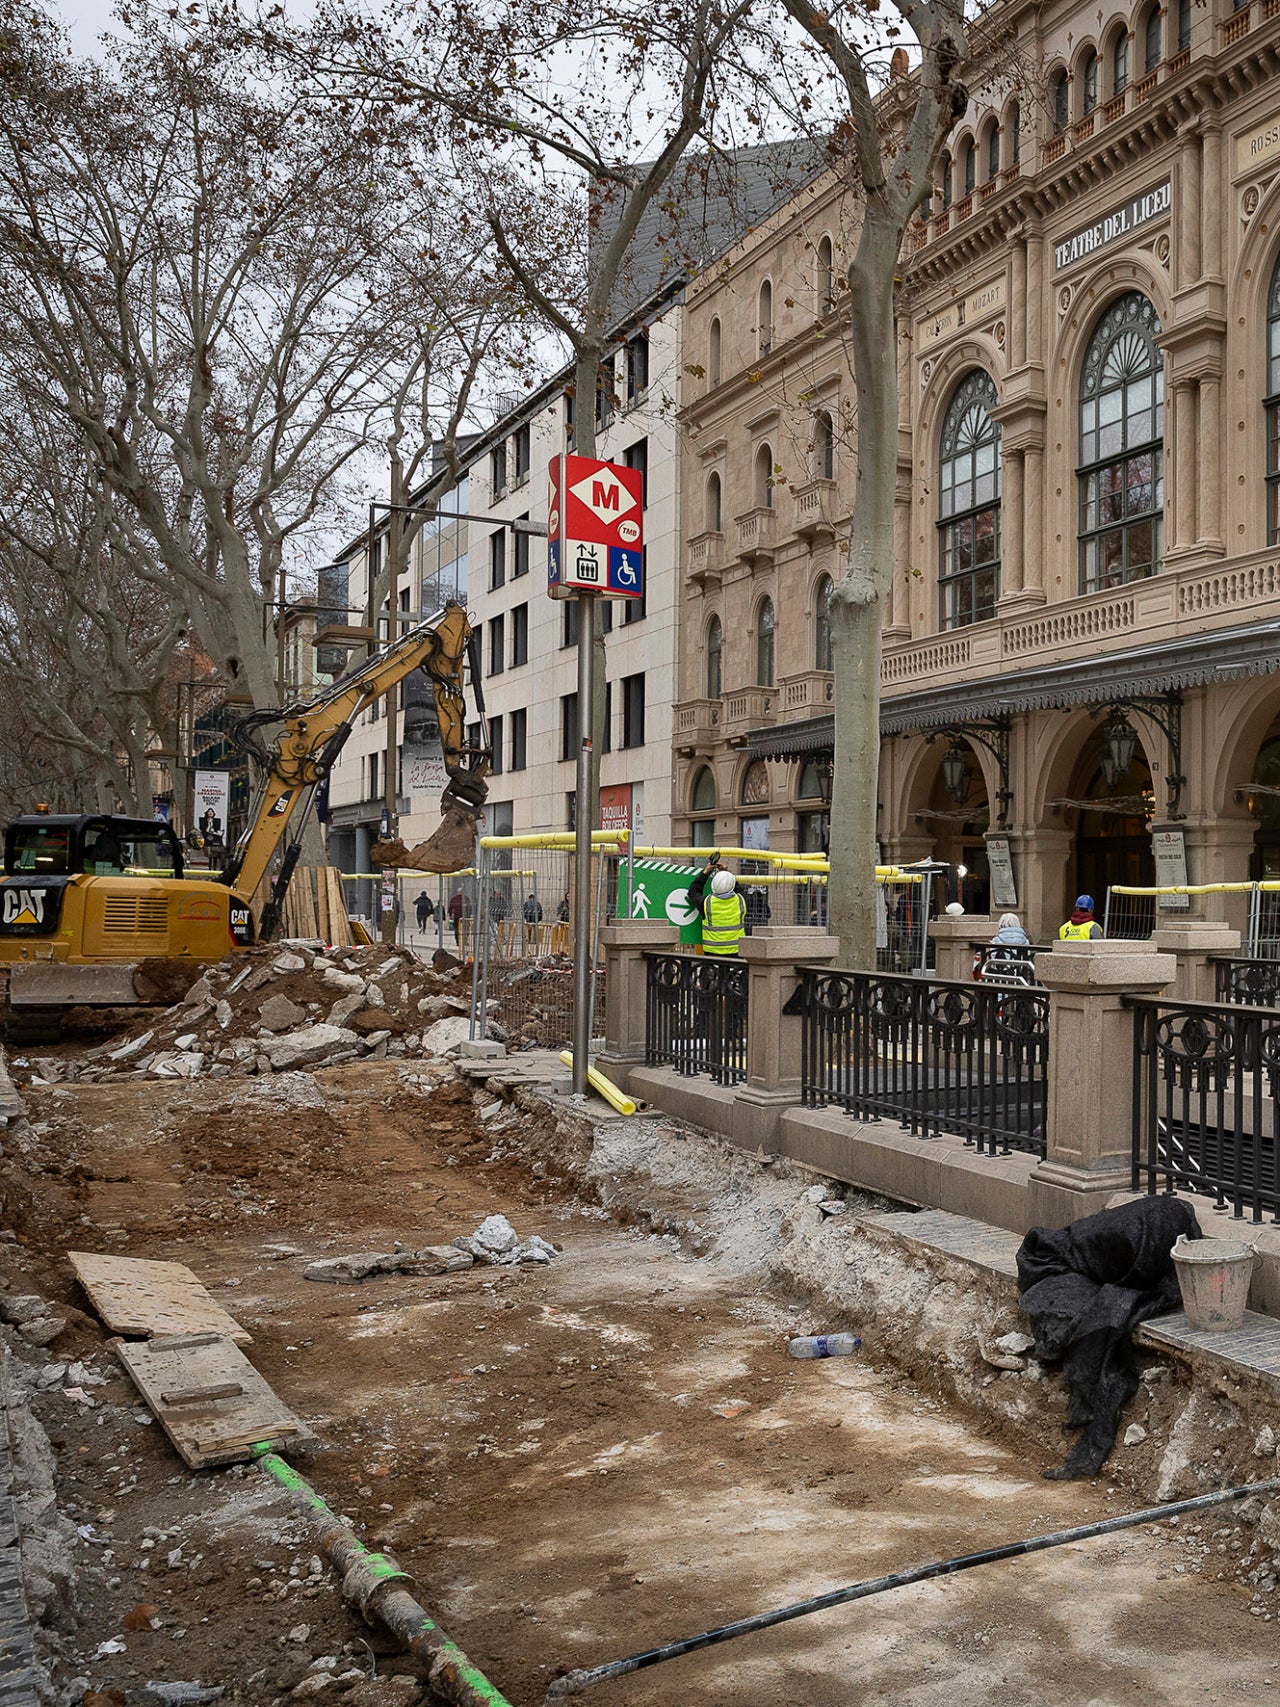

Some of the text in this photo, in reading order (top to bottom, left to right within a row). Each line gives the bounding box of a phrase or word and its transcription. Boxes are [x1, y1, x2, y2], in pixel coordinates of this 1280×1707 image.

[1055, 183, 1171, 269] TEATRE DEL LICEU
[972, 286, 1001, 313] MOZART
[592, 480, 620, 512] M
[622, 527, 638, 537] TMB
[602, 804, 628, 819] TAQUILLA
[3, 889, 47, 924] CAT
[230, 909, 250, 925] CAT
